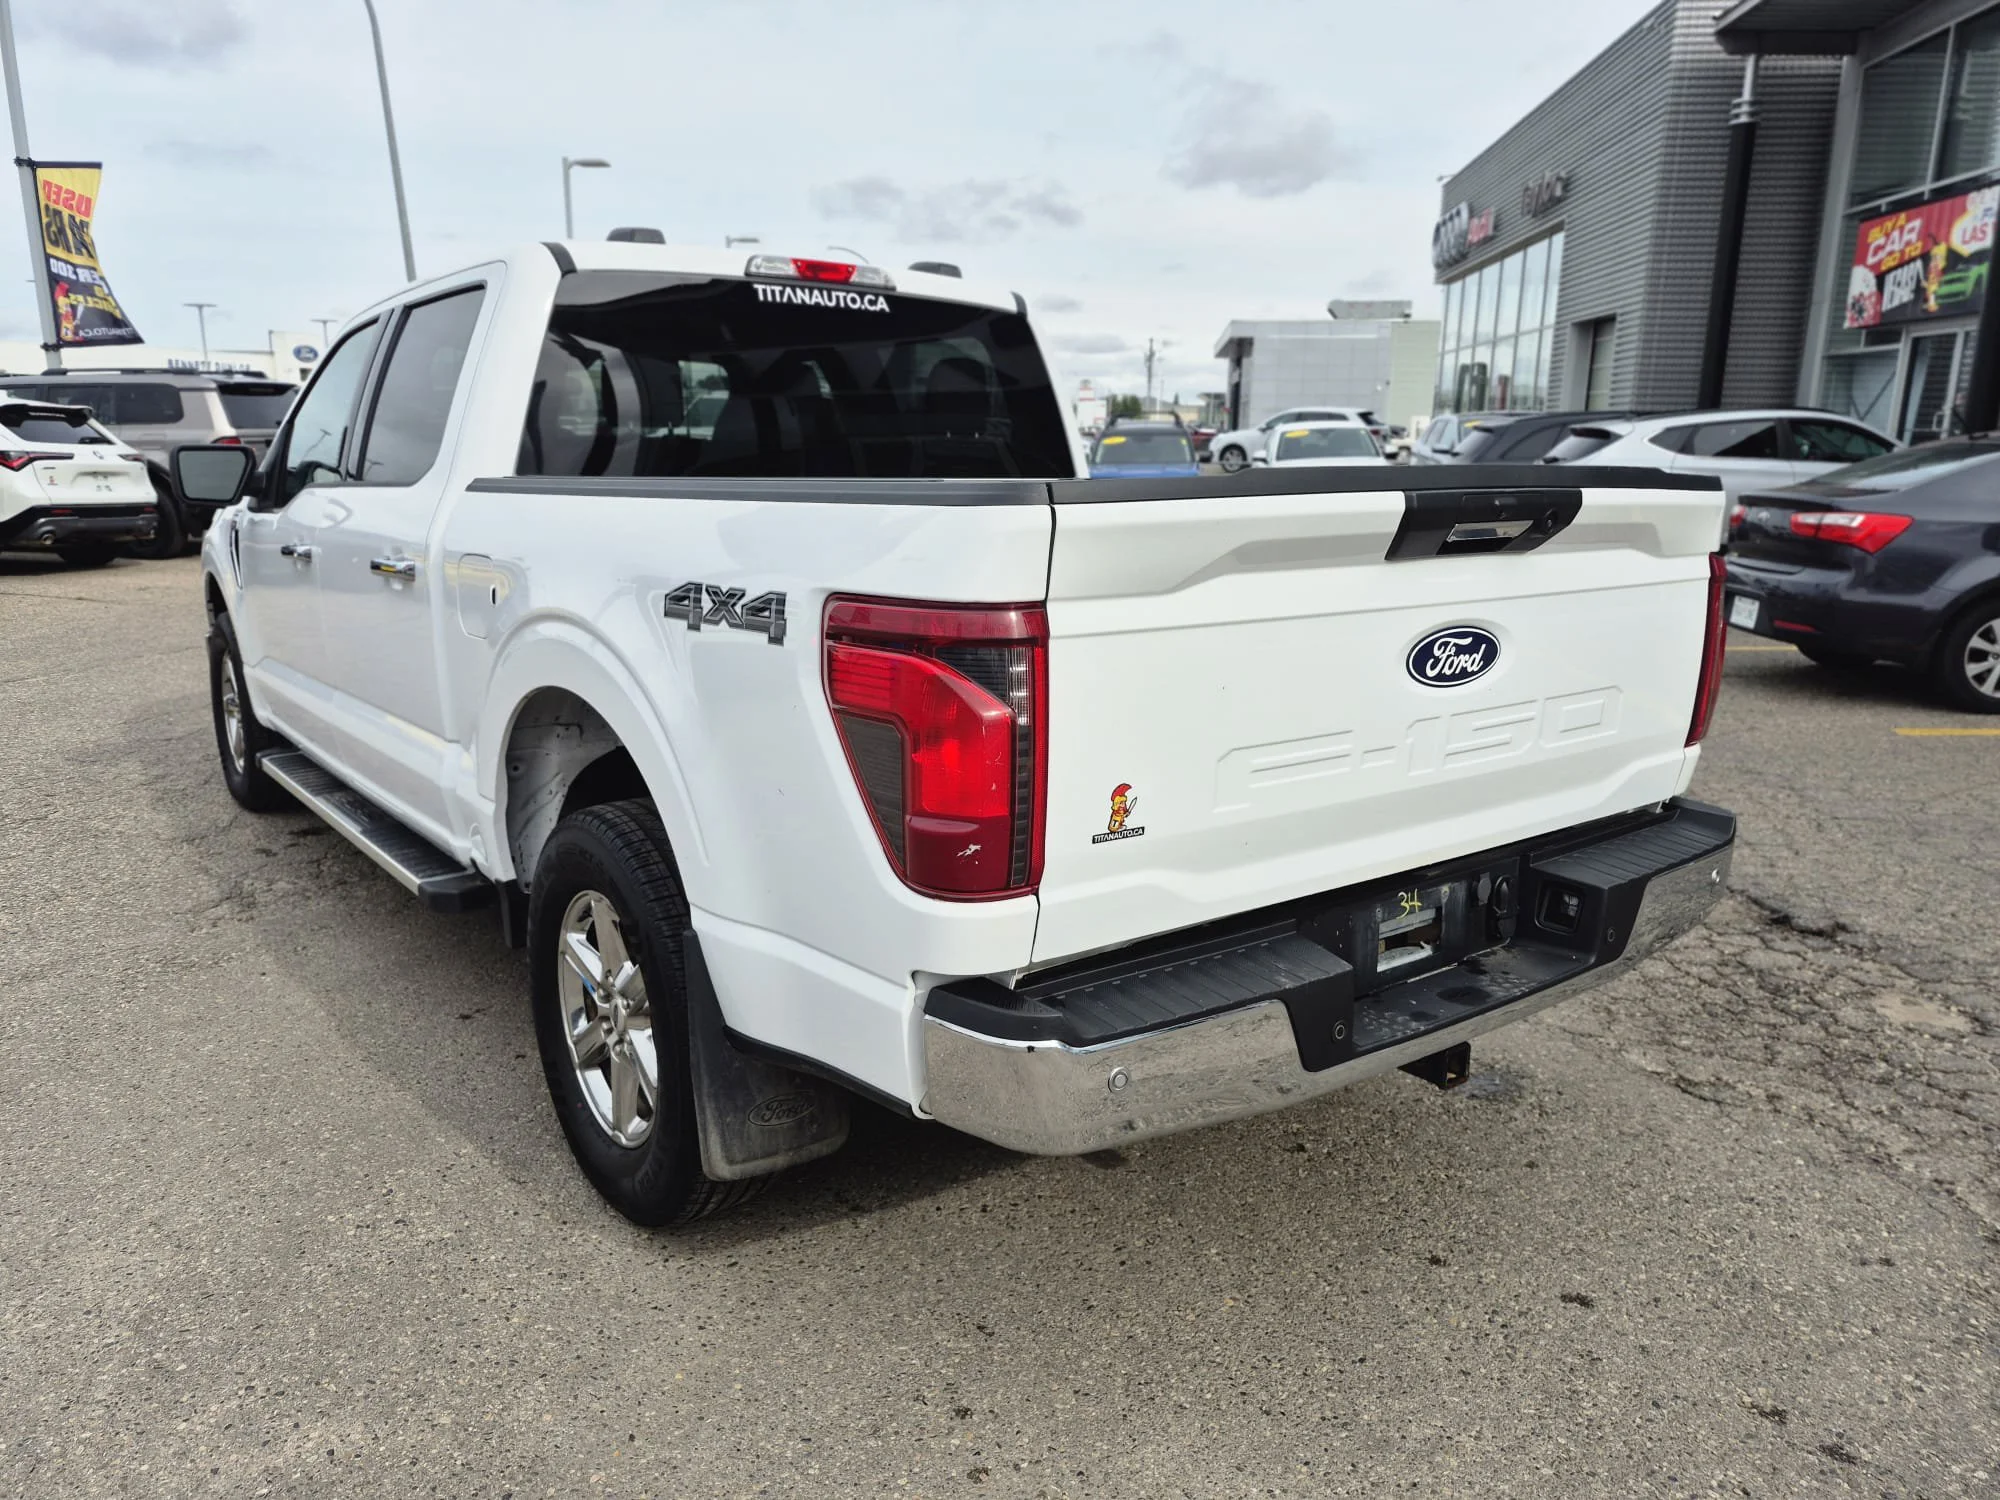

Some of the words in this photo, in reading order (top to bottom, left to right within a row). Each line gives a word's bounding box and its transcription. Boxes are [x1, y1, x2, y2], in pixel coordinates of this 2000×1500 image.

[1866, 219, 1921, 266] CAR
[753, 283, 890, 313] TITANAUTO.CA
[1425, 636, 1486, 677] Ford
[1211, 685, 1624, 814] F-150
[1094, 828, 1144, 843] TITANAUTO.CA
[1396, 888, 1422, 919] 34
